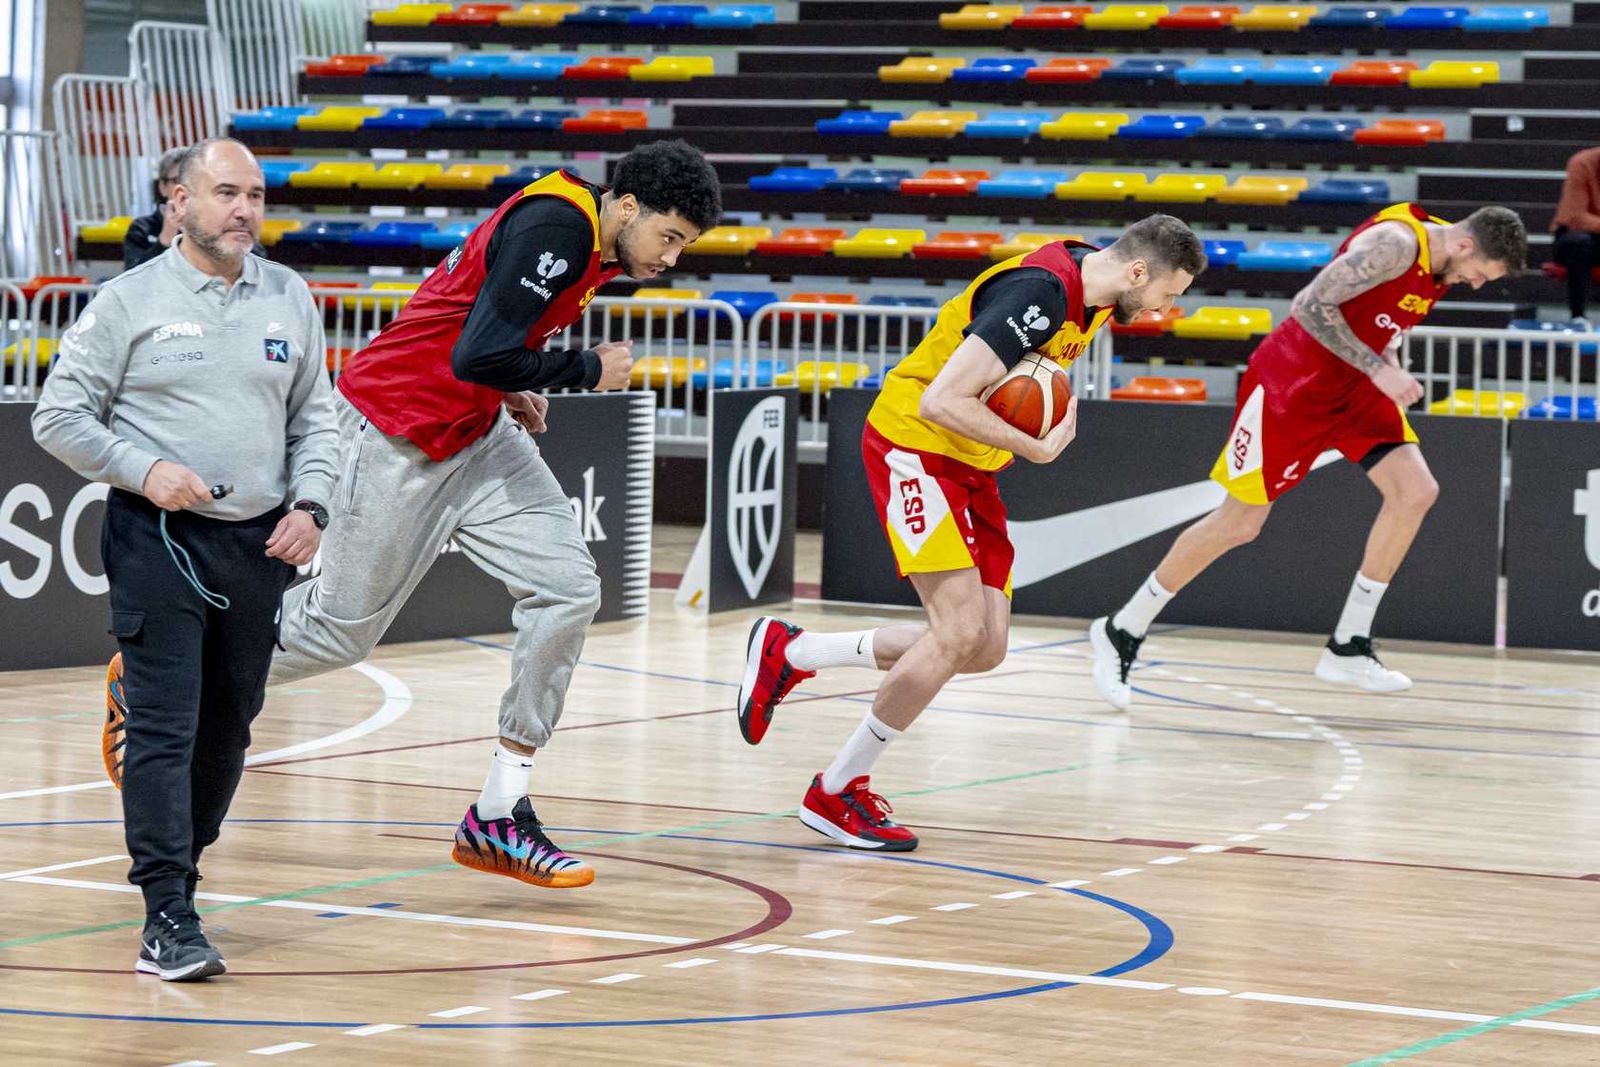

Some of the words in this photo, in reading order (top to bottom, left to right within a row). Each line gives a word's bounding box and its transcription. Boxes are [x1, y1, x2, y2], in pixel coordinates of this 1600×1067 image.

[152, 321, 203, 343] ESPAÑA
[150, 351, 204, 365] eesa
[1234, 426, 1252, 471] ESP
[900, 478, 926, 535] ESP
